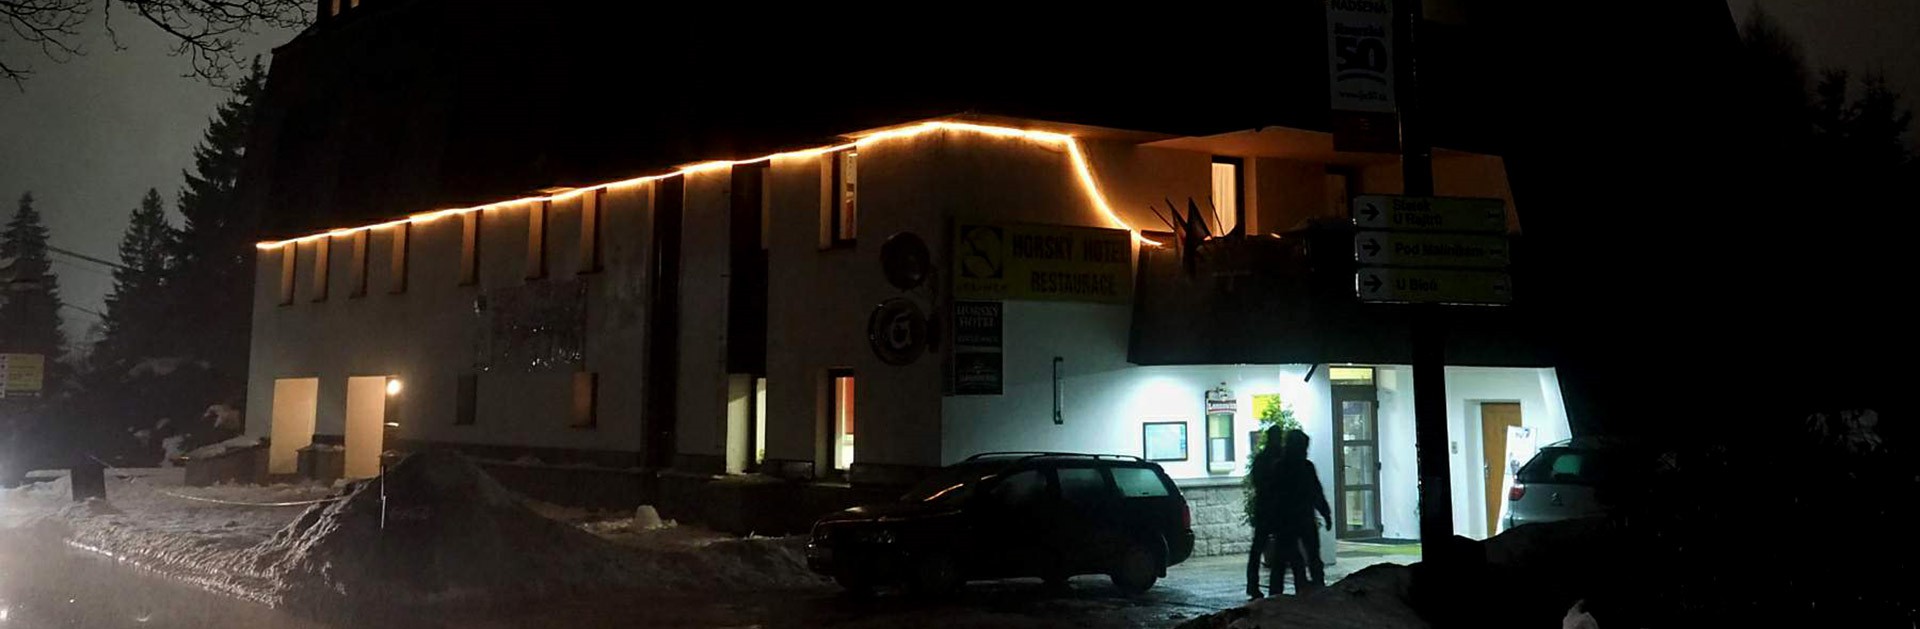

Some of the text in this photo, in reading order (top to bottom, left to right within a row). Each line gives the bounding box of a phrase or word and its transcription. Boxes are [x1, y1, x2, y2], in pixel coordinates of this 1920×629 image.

[1336, 37, 1387, 73] 50
[1393, 213, 1402, 224] U
[1083, 236, 1128, 263] HOTEL
[1395, 242, 1419, 255] Pod
[1031, 270, 1117, 296] RESTAURACE
[1396, 278, 1405, 290] U
